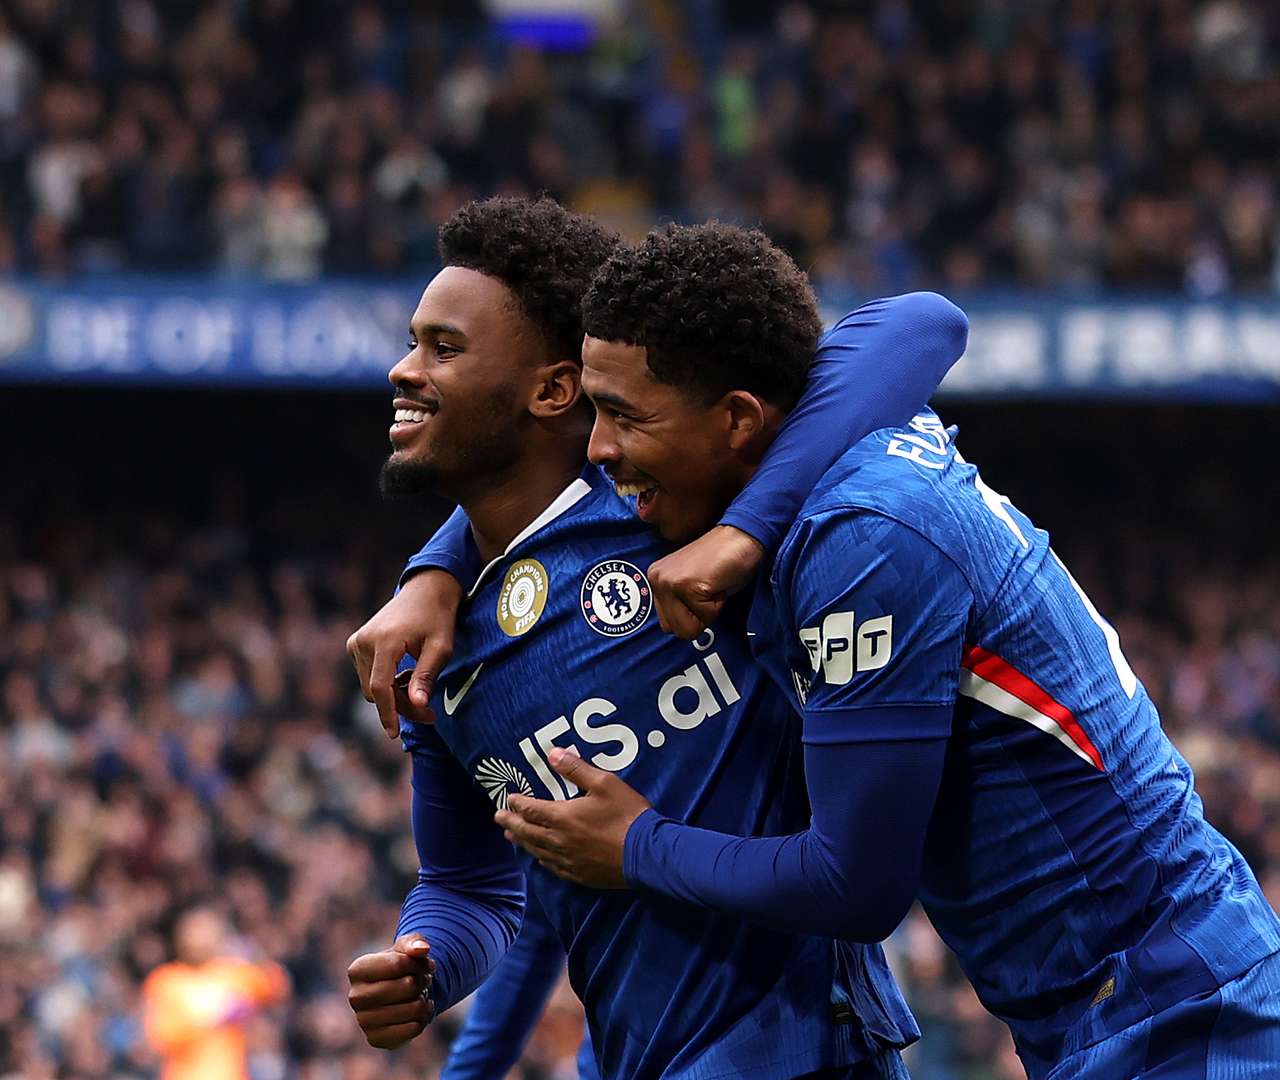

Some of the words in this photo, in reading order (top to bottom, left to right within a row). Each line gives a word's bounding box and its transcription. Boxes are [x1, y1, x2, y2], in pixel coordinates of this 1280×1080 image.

[585, 562, 626, 591] CHELSEA
[500, 582, 513, 621] WORLD
[510, 563, 544, 593] CHAMPIONS
[515, 609, 537, 632] FIFA
[603, 621, 637, 634] FOOTBALL
[518, 628, 742, 802] IFS.ai
